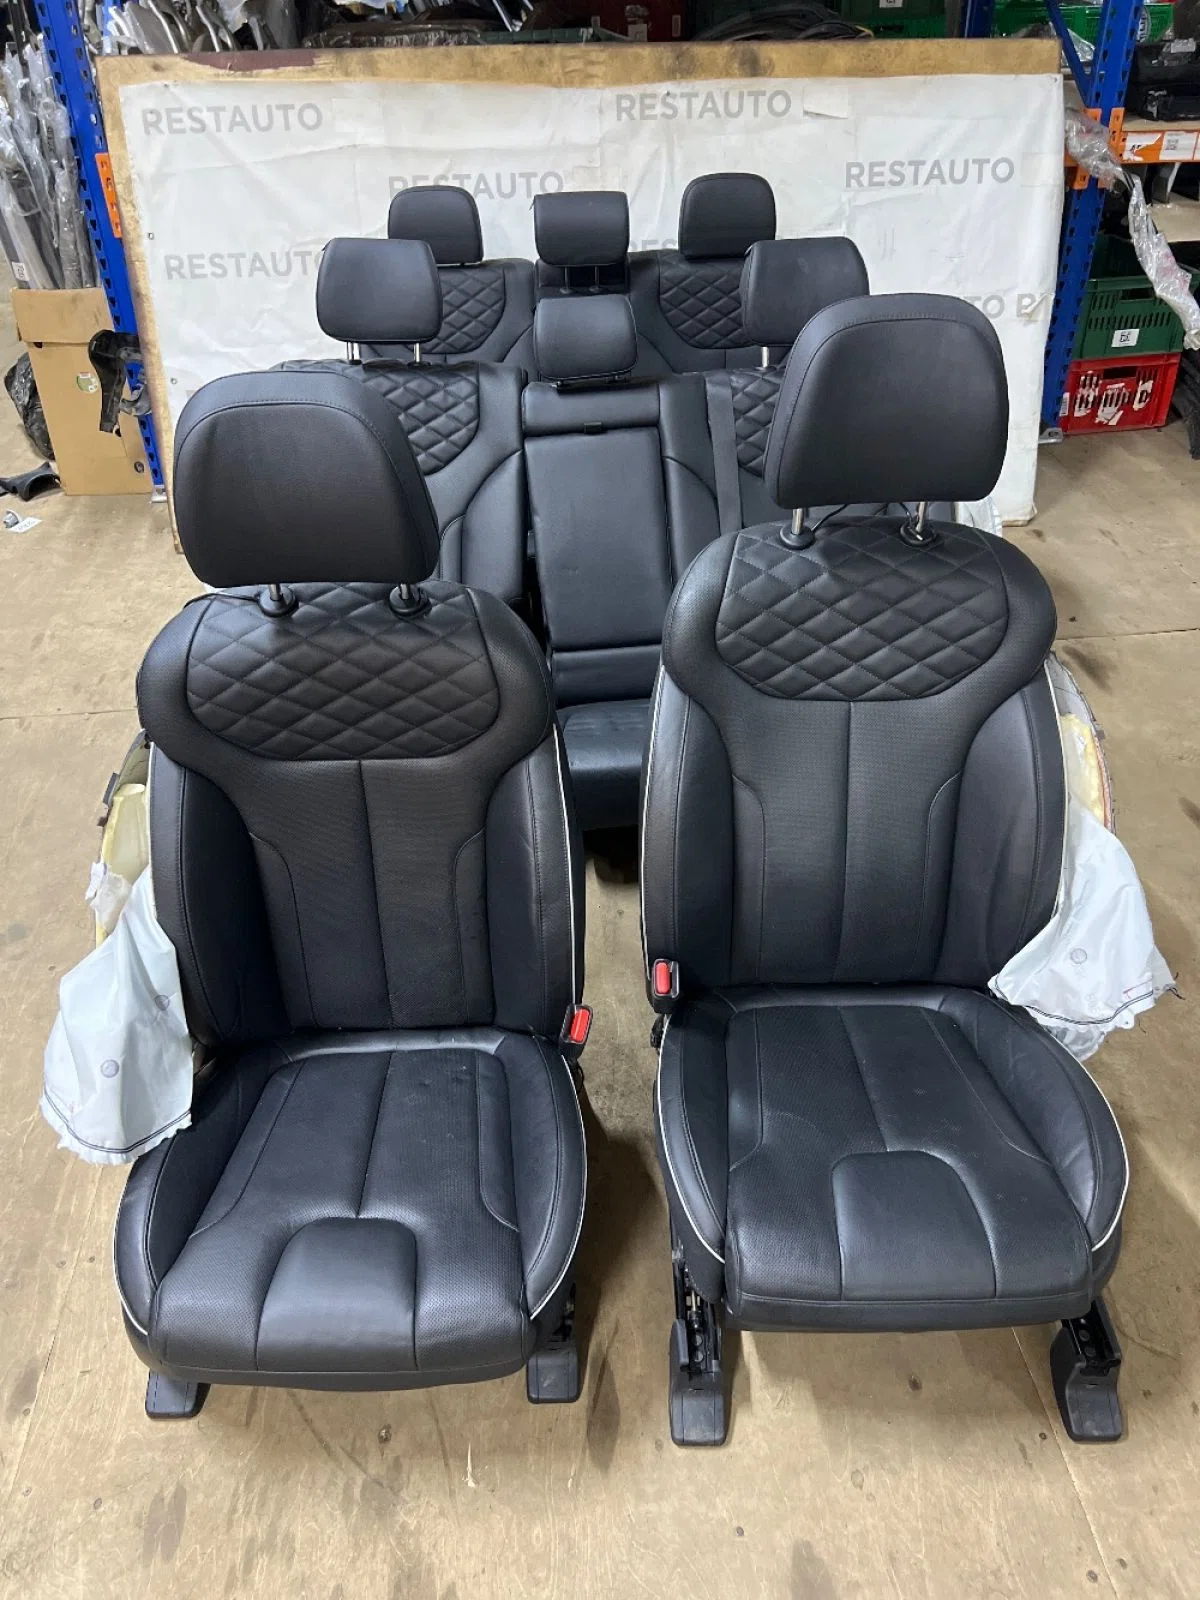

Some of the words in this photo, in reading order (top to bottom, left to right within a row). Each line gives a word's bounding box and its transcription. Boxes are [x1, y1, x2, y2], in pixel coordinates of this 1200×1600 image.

[141, 102, 323, 135] RESTAUTO
[615, 89, 792, 121] RESTAUTO
[845, 156, 1015, 188] RESTAUTO
[164, 250, 319, 280] RESTAUT
